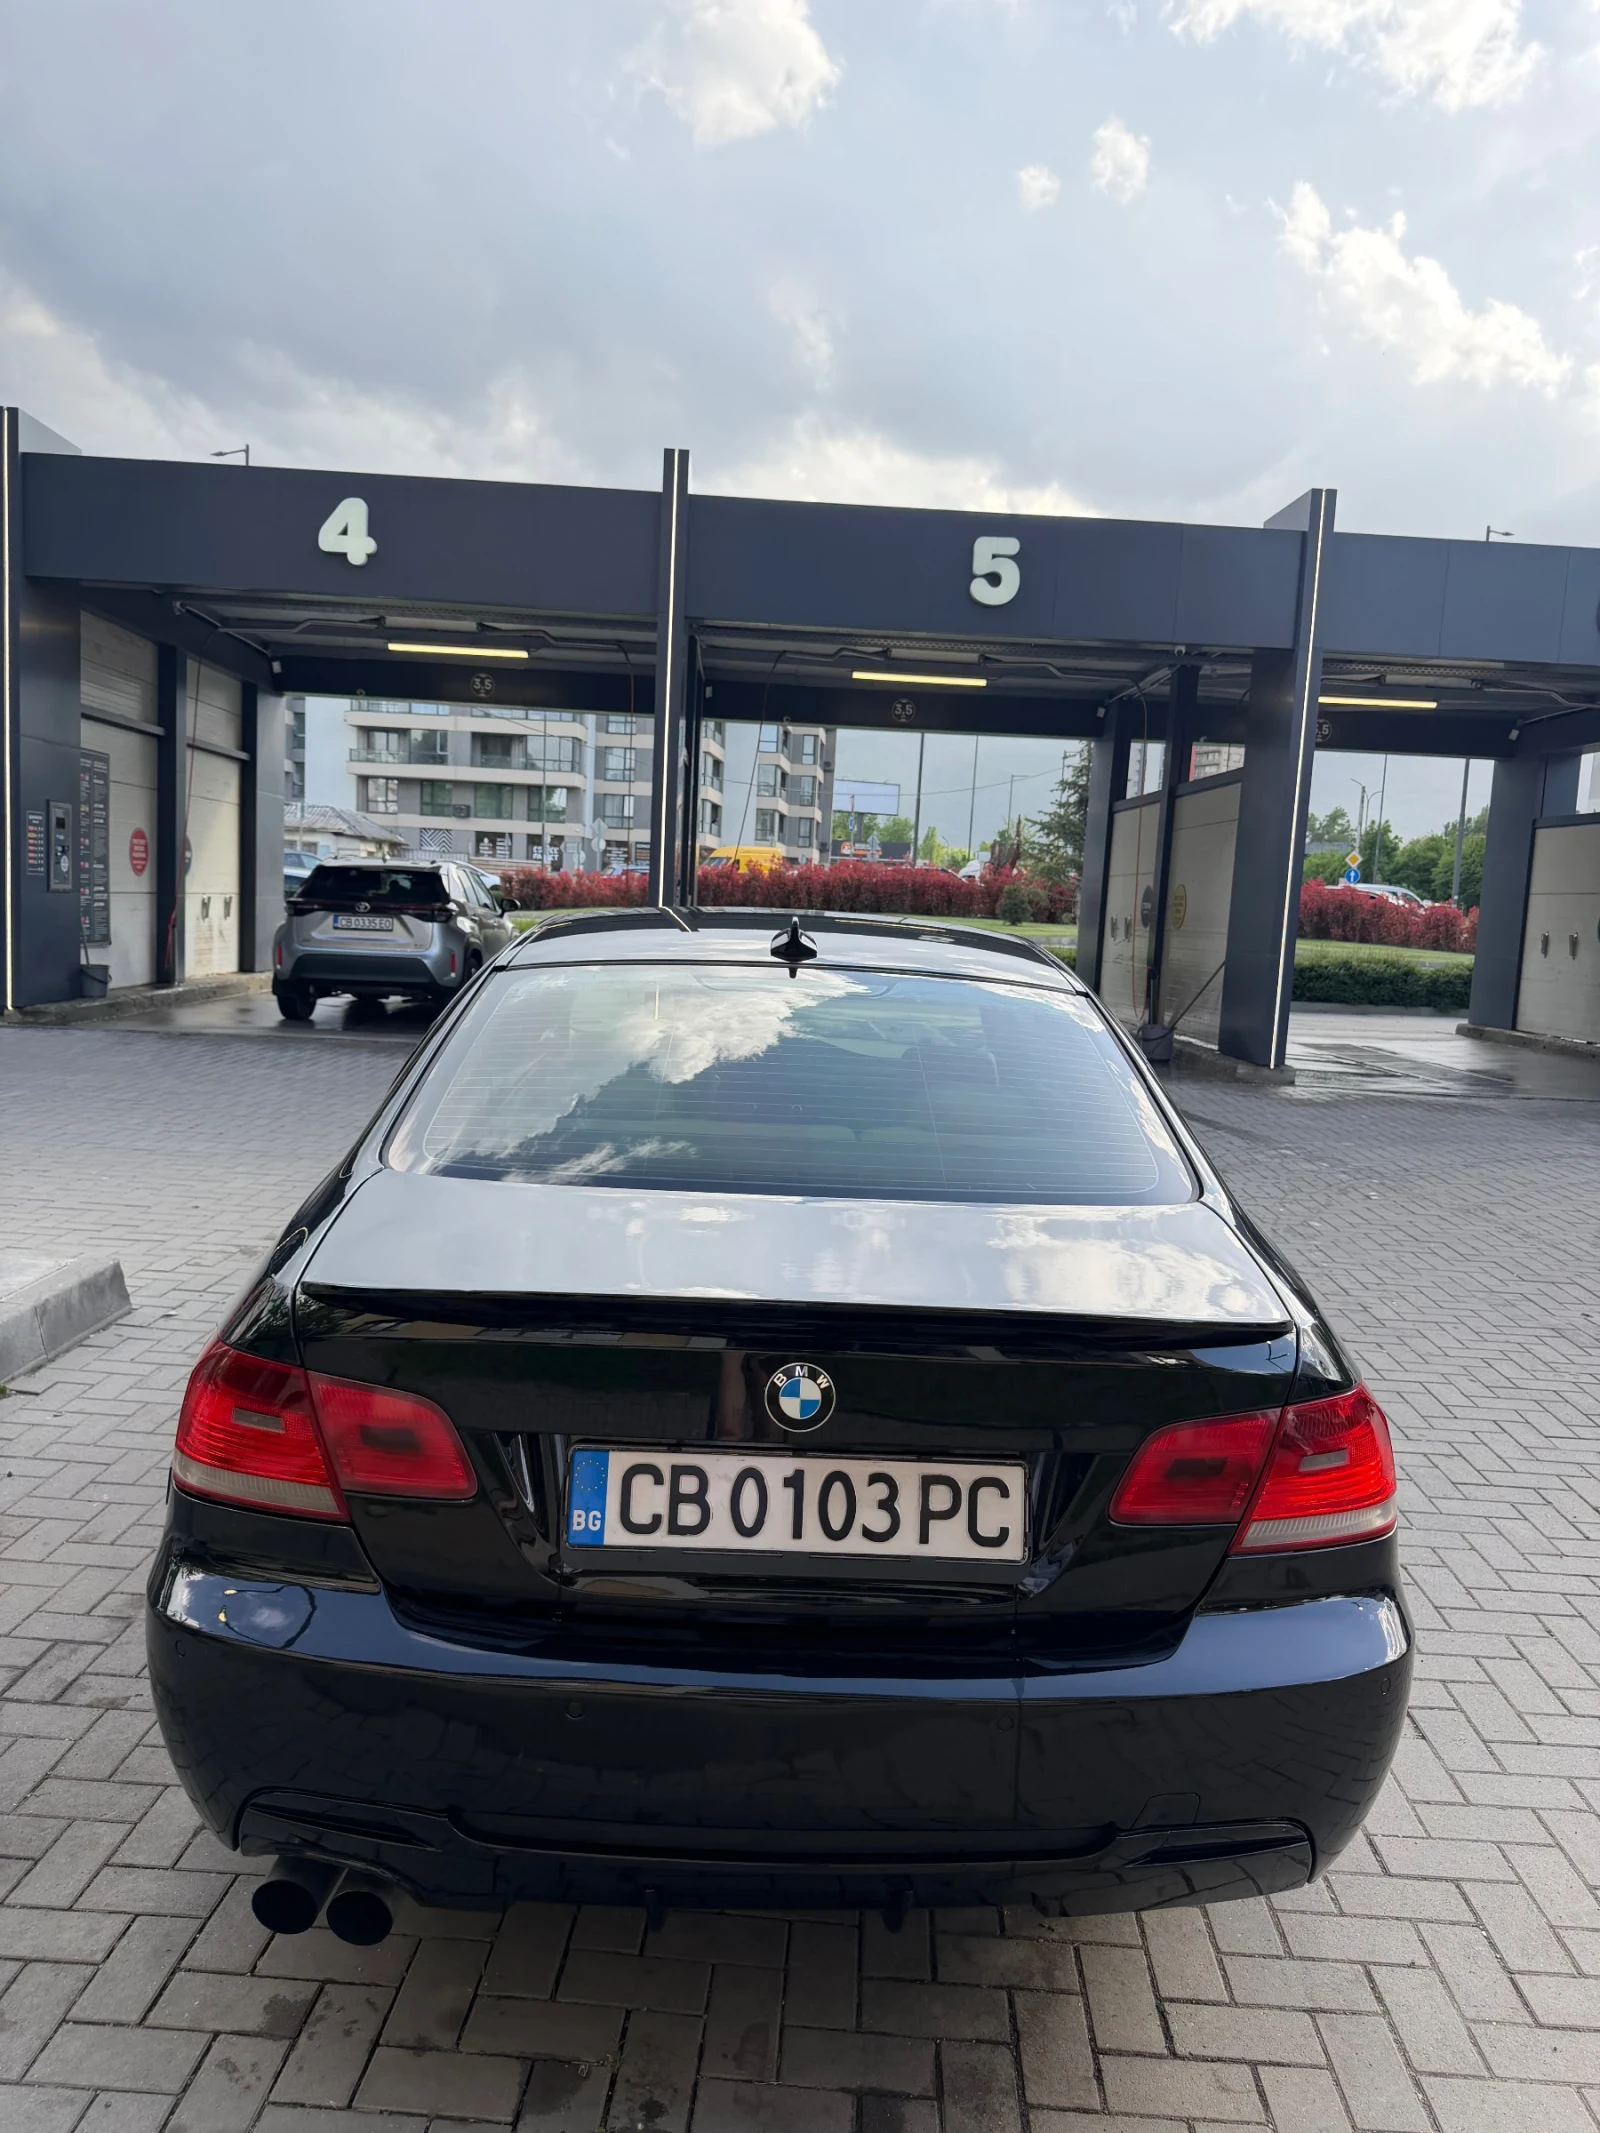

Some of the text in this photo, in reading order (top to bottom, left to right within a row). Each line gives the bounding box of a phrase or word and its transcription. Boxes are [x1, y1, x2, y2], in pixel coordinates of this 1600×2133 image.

[318, 497, 378, 566] 4
[970, 536, 1020, 606] 5
[473, 678, 492, 690] 3.5
[895, 703, 913, 715] 3.5
[773, 1365, 831, 1390] BMW
[620, 1463, 1010, 1548] CB 0103 PC
[572, 1509, 601, 1531] BG
